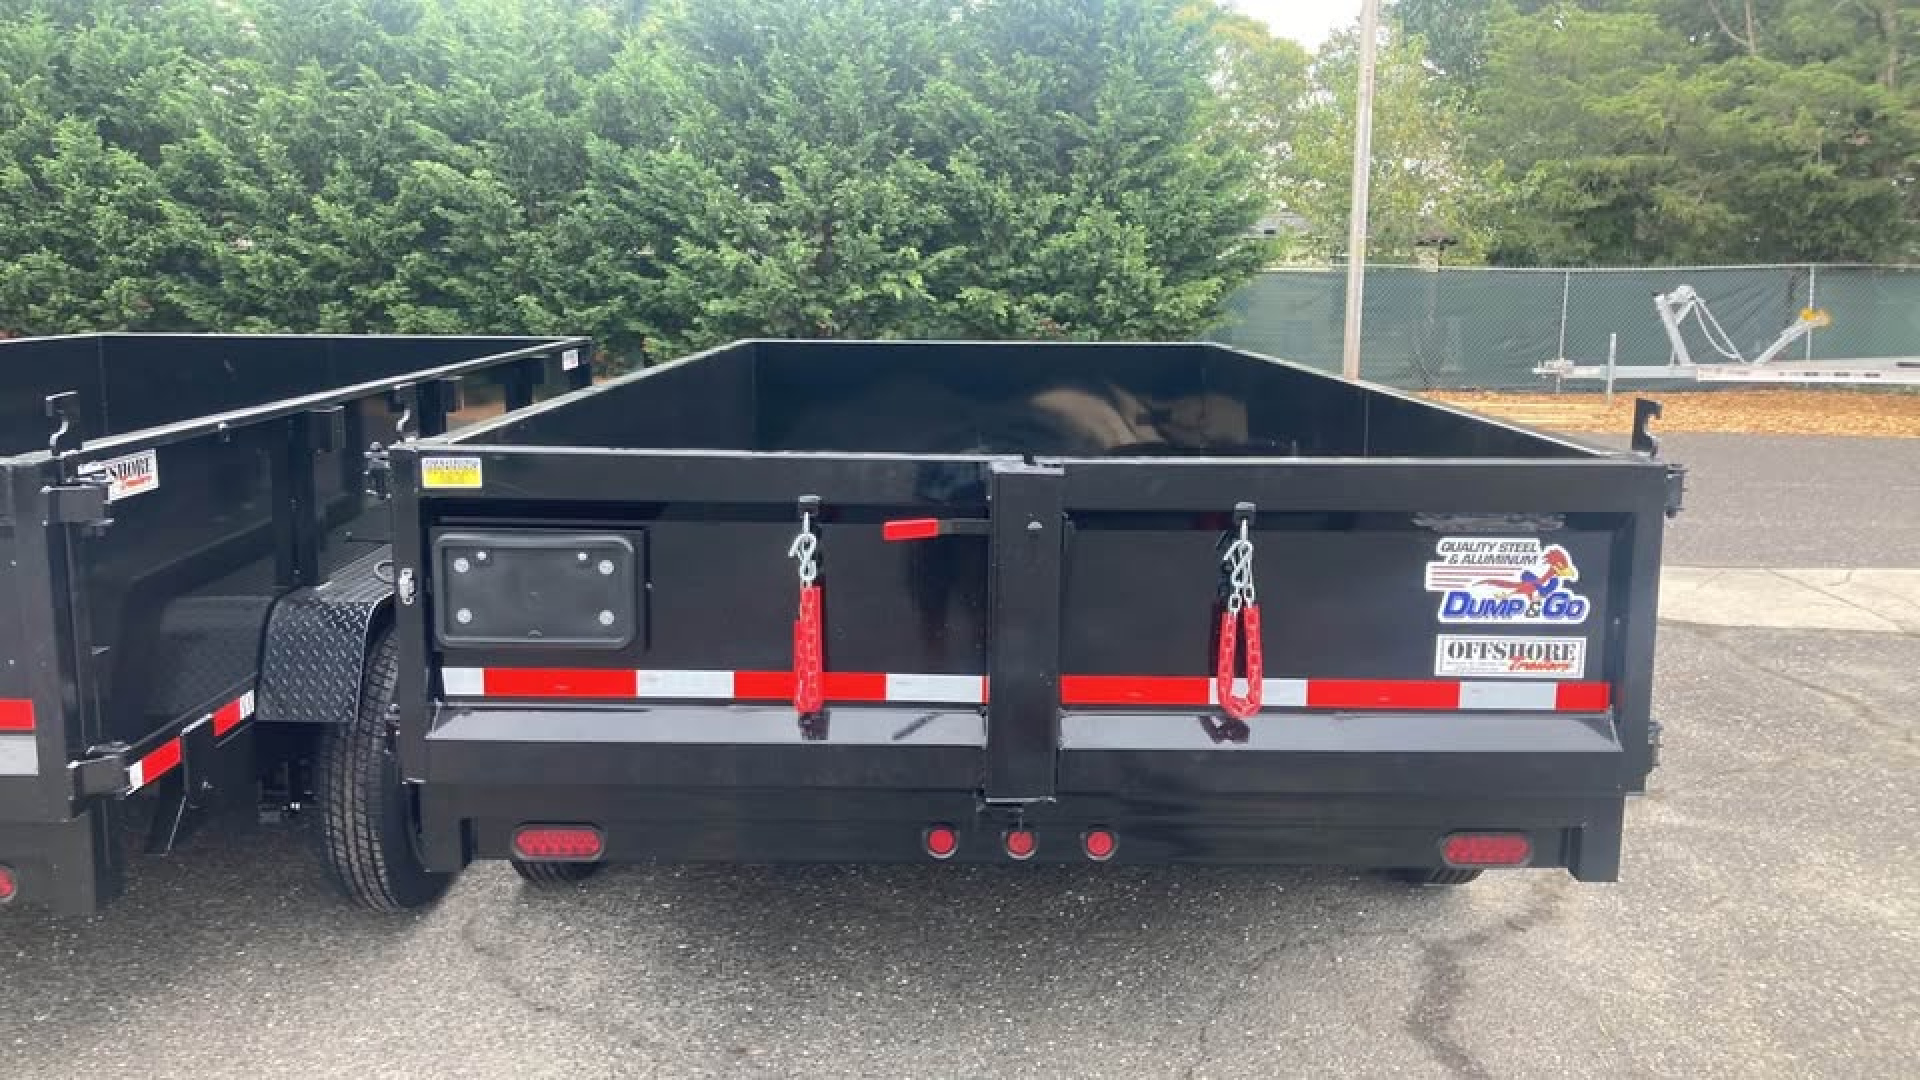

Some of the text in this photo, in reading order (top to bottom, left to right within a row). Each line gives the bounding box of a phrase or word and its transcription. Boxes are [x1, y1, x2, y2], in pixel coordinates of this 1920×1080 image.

[1441, 541, 1537, 553] QUALITY STEEL
[1448, 553, 1538, 564] & ALUMINUM
[1447, 641, 1576, 660] OFFSHORE
